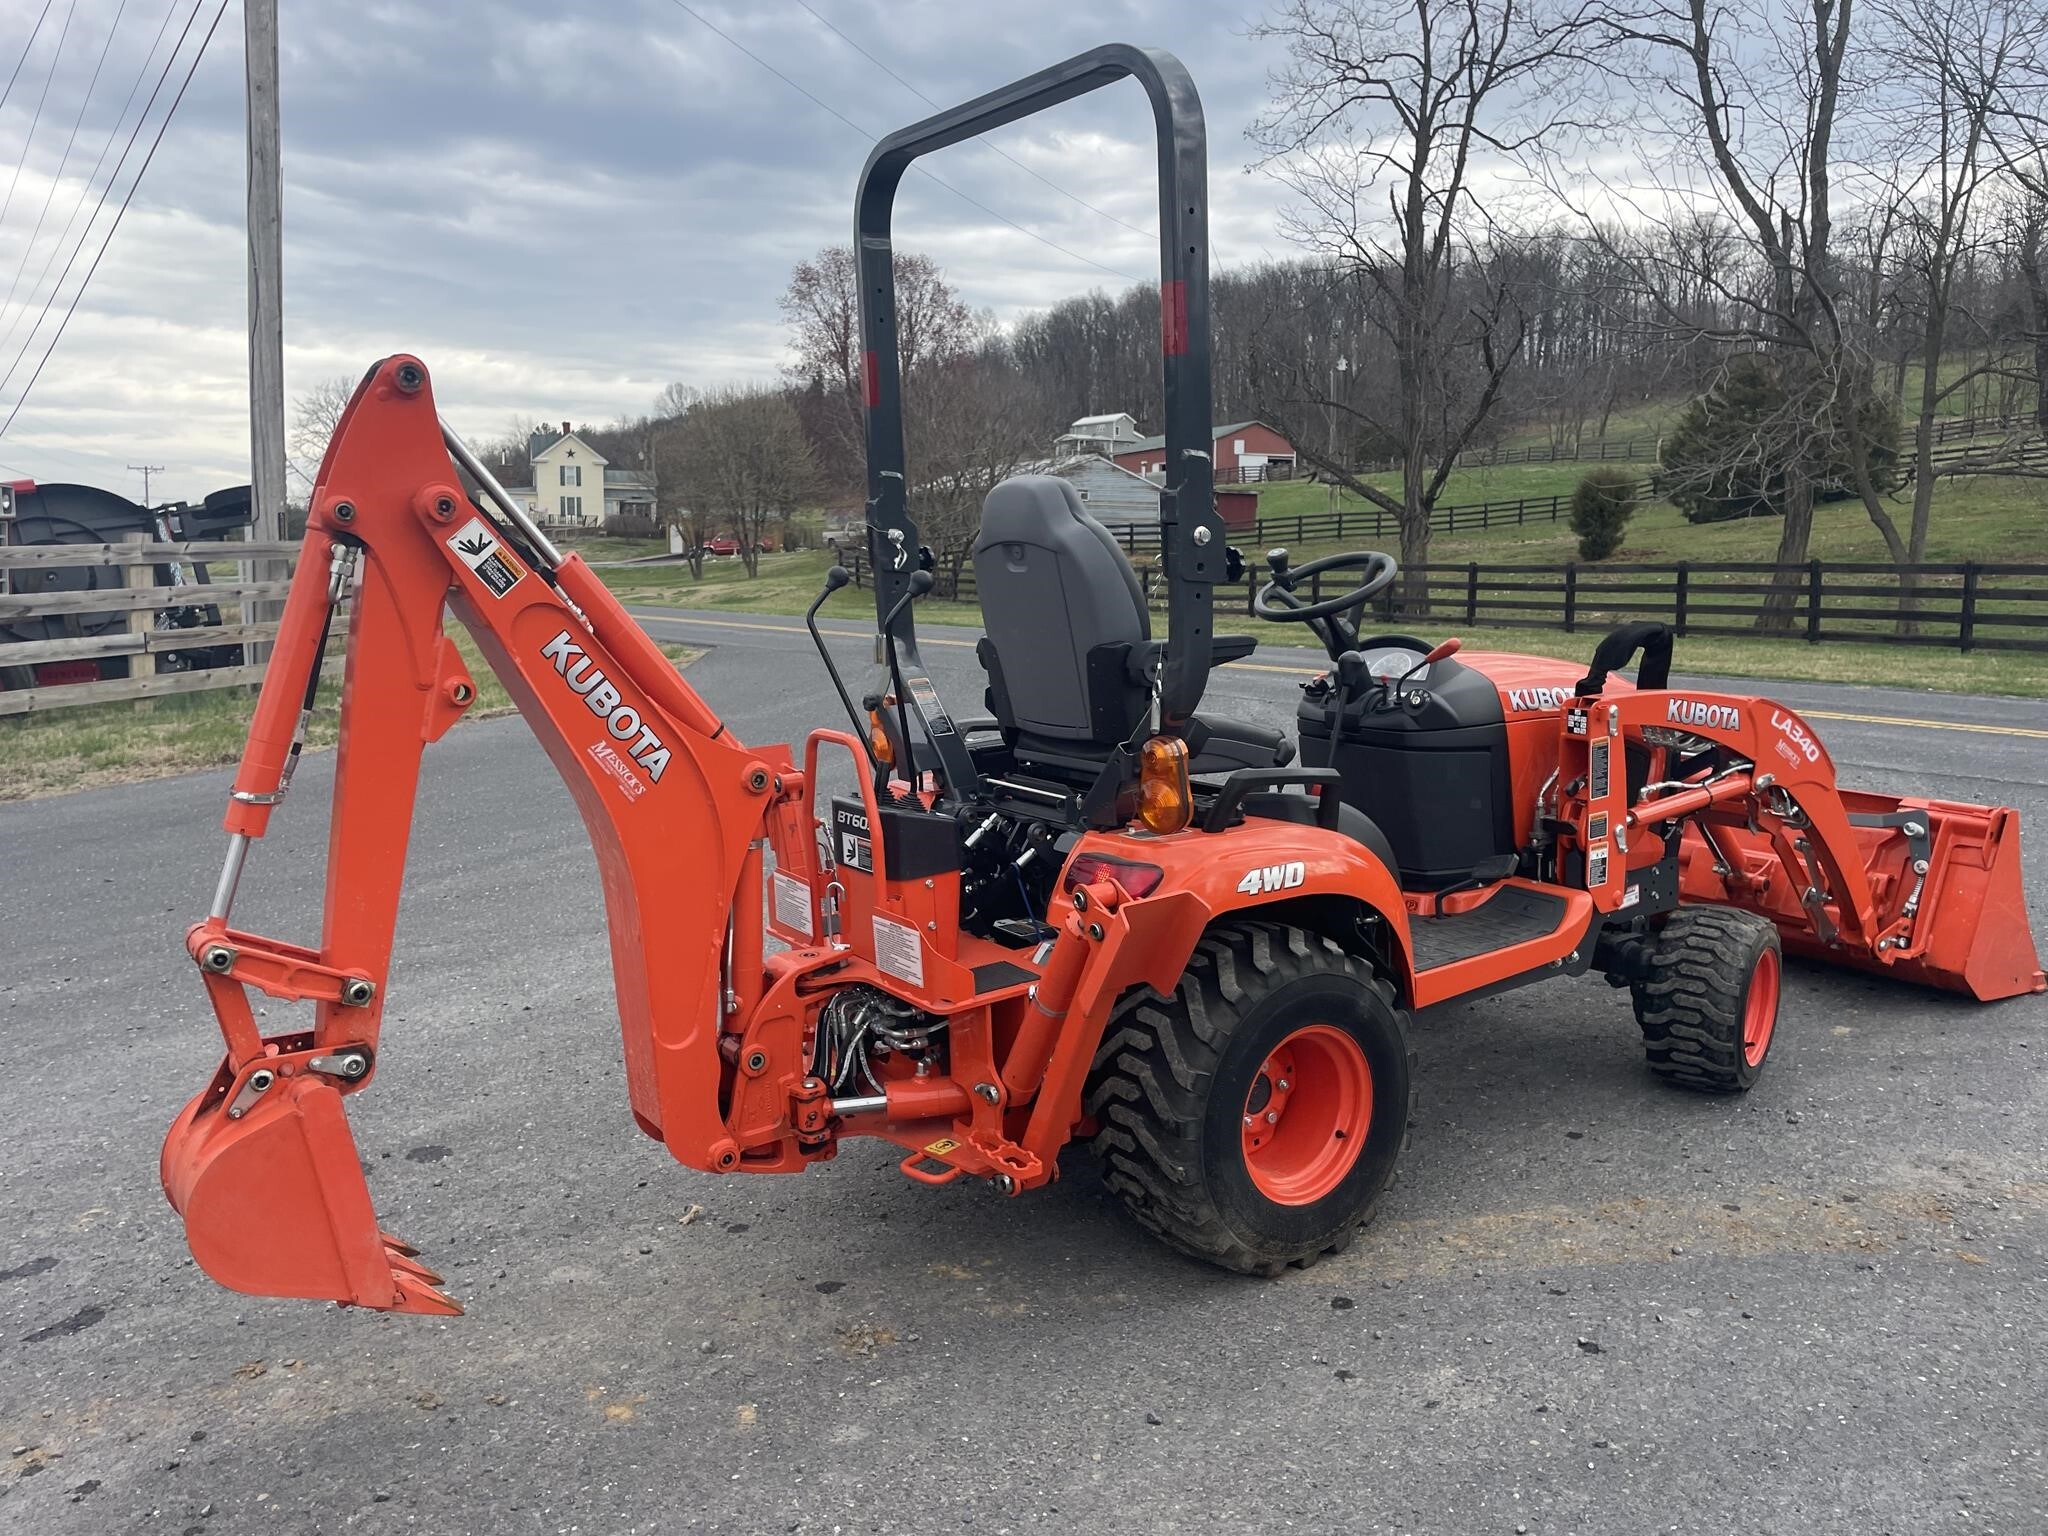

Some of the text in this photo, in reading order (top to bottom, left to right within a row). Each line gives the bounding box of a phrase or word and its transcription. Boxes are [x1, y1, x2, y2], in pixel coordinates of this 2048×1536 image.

[540, 630, 673, 784] KUBOTA
[1508, 687, 1576, 711] KUBOT
[1667, 698, 1740, 731] KUBOTA
[1771, 710, 1819, 762] LA340
[590, 740, 647, 795] MESSICK'S
[837, 810, 870, 831] BT60
[1236, 861, 1305, 896] 4WD
